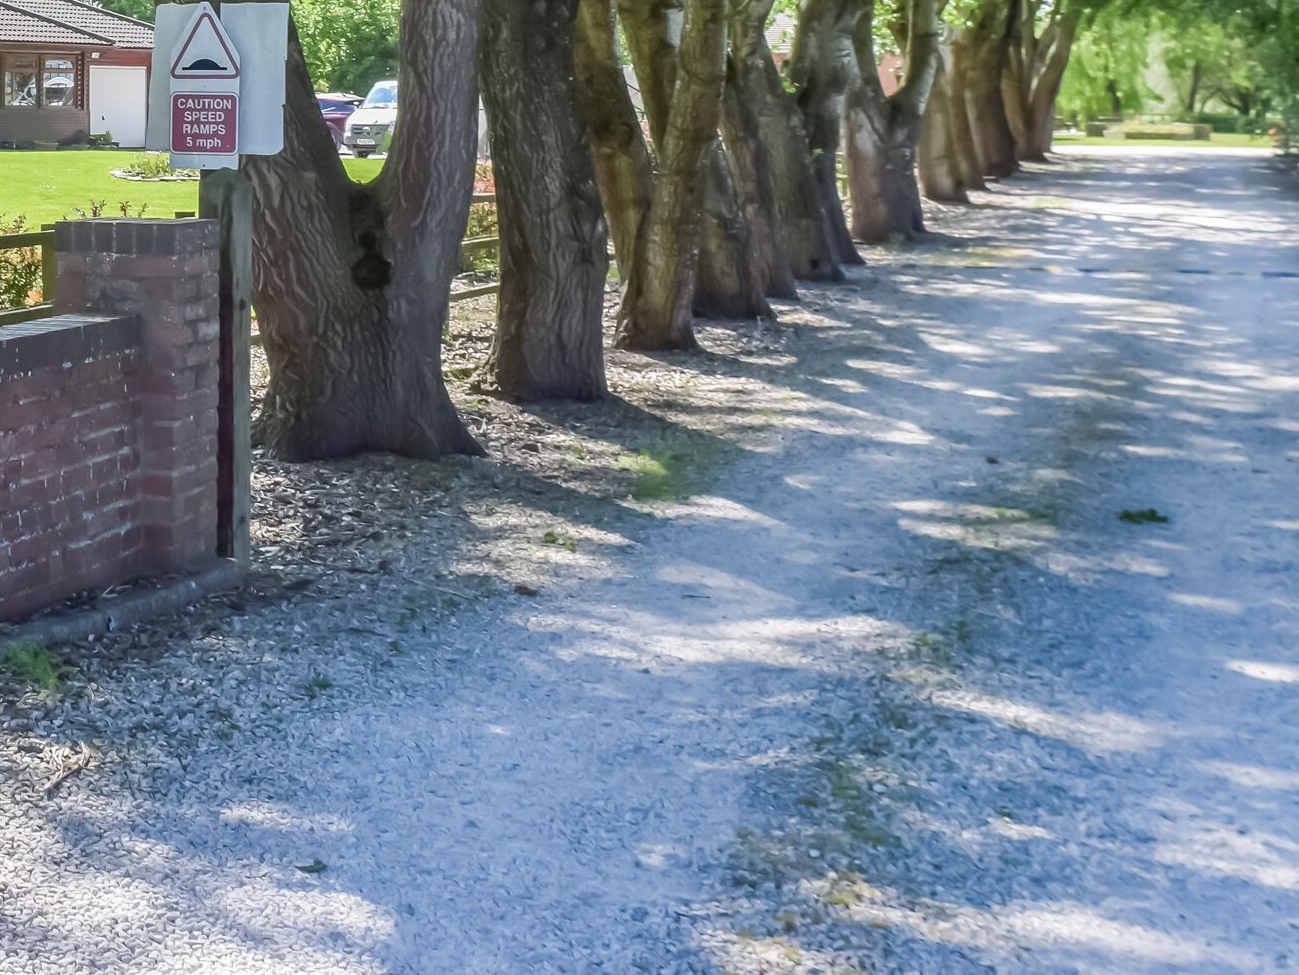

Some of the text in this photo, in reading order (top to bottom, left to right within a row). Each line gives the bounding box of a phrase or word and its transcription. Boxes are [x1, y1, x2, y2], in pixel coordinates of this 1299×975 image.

[177, 98, 232, 109] CAUTION
[184, 111, 225, 122] SPEED
[182, 124, 226, 135] RAMPS
[186, 137, 222, 149] 5 mph
